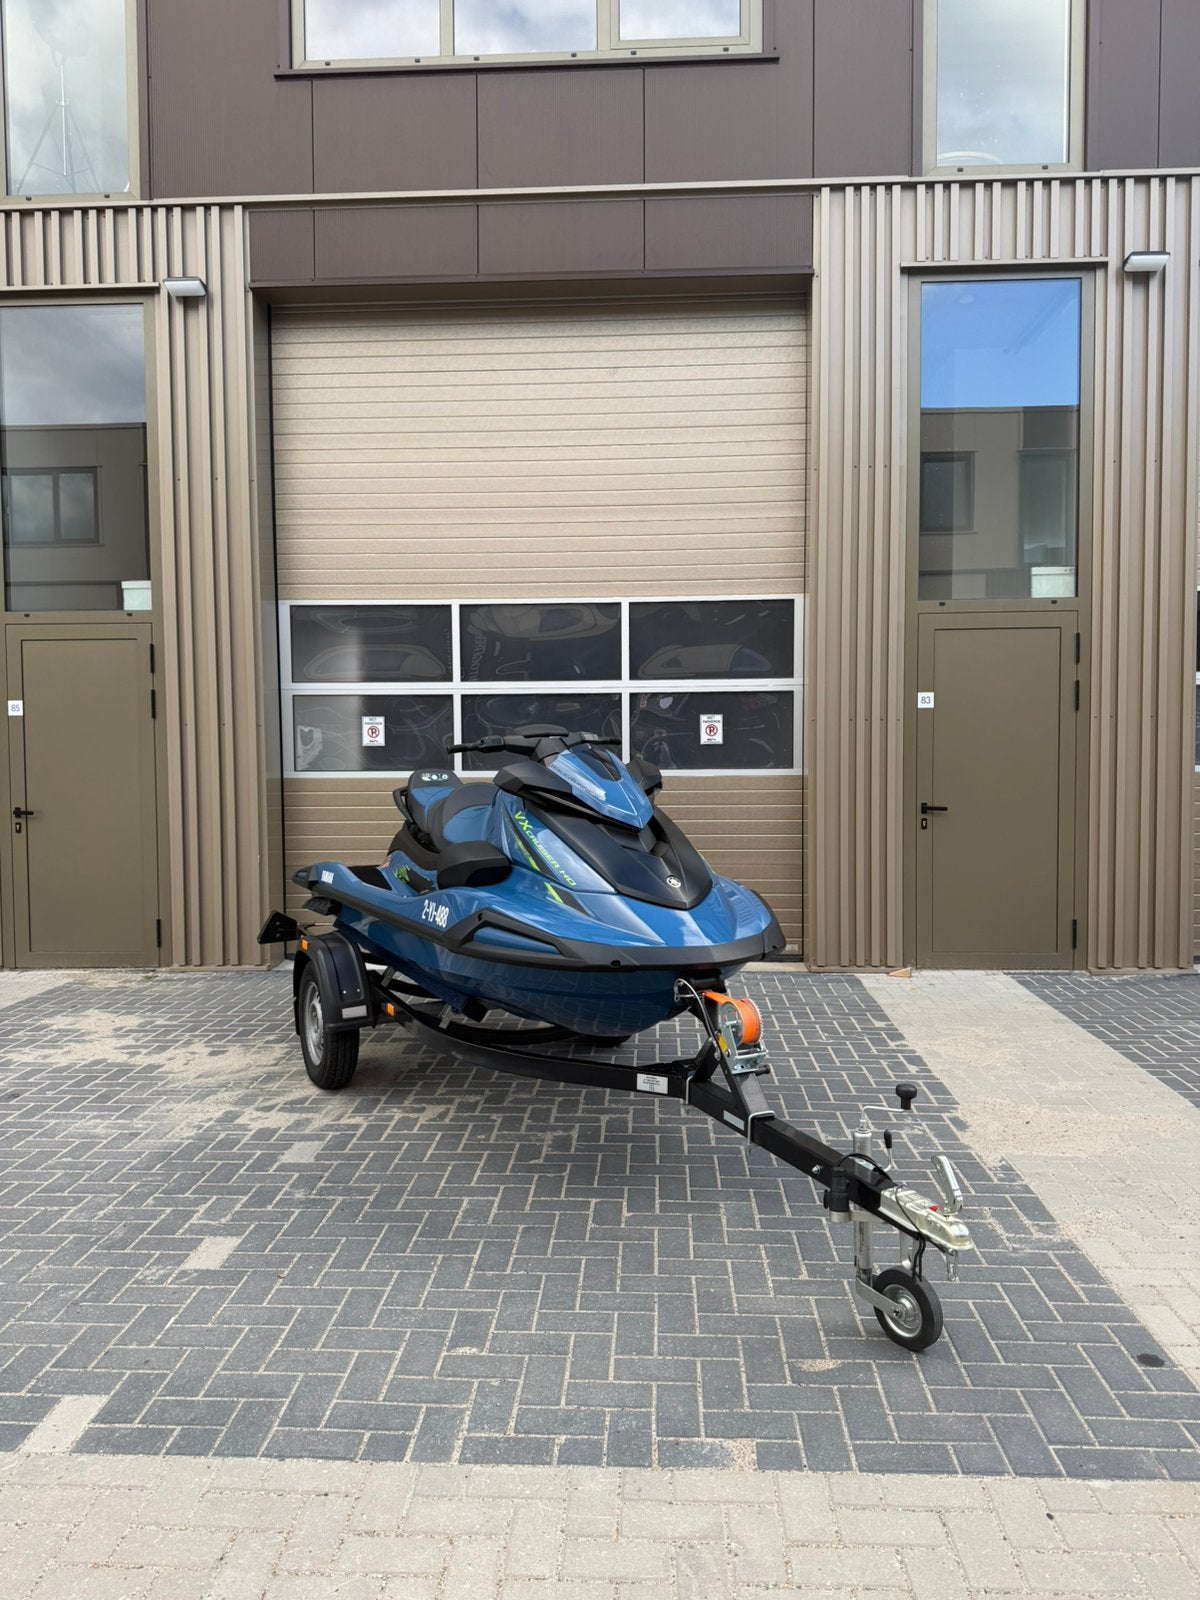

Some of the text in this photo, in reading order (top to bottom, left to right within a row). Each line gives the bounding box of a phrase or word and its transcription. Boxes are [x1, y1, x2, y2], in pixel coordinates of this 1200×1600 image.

[921, 696, 931, 705] 83
[10, 704, 21, 712] 85
[514, 811, 533, 831] VX
[526, 830, 560, 869] CRUISER
